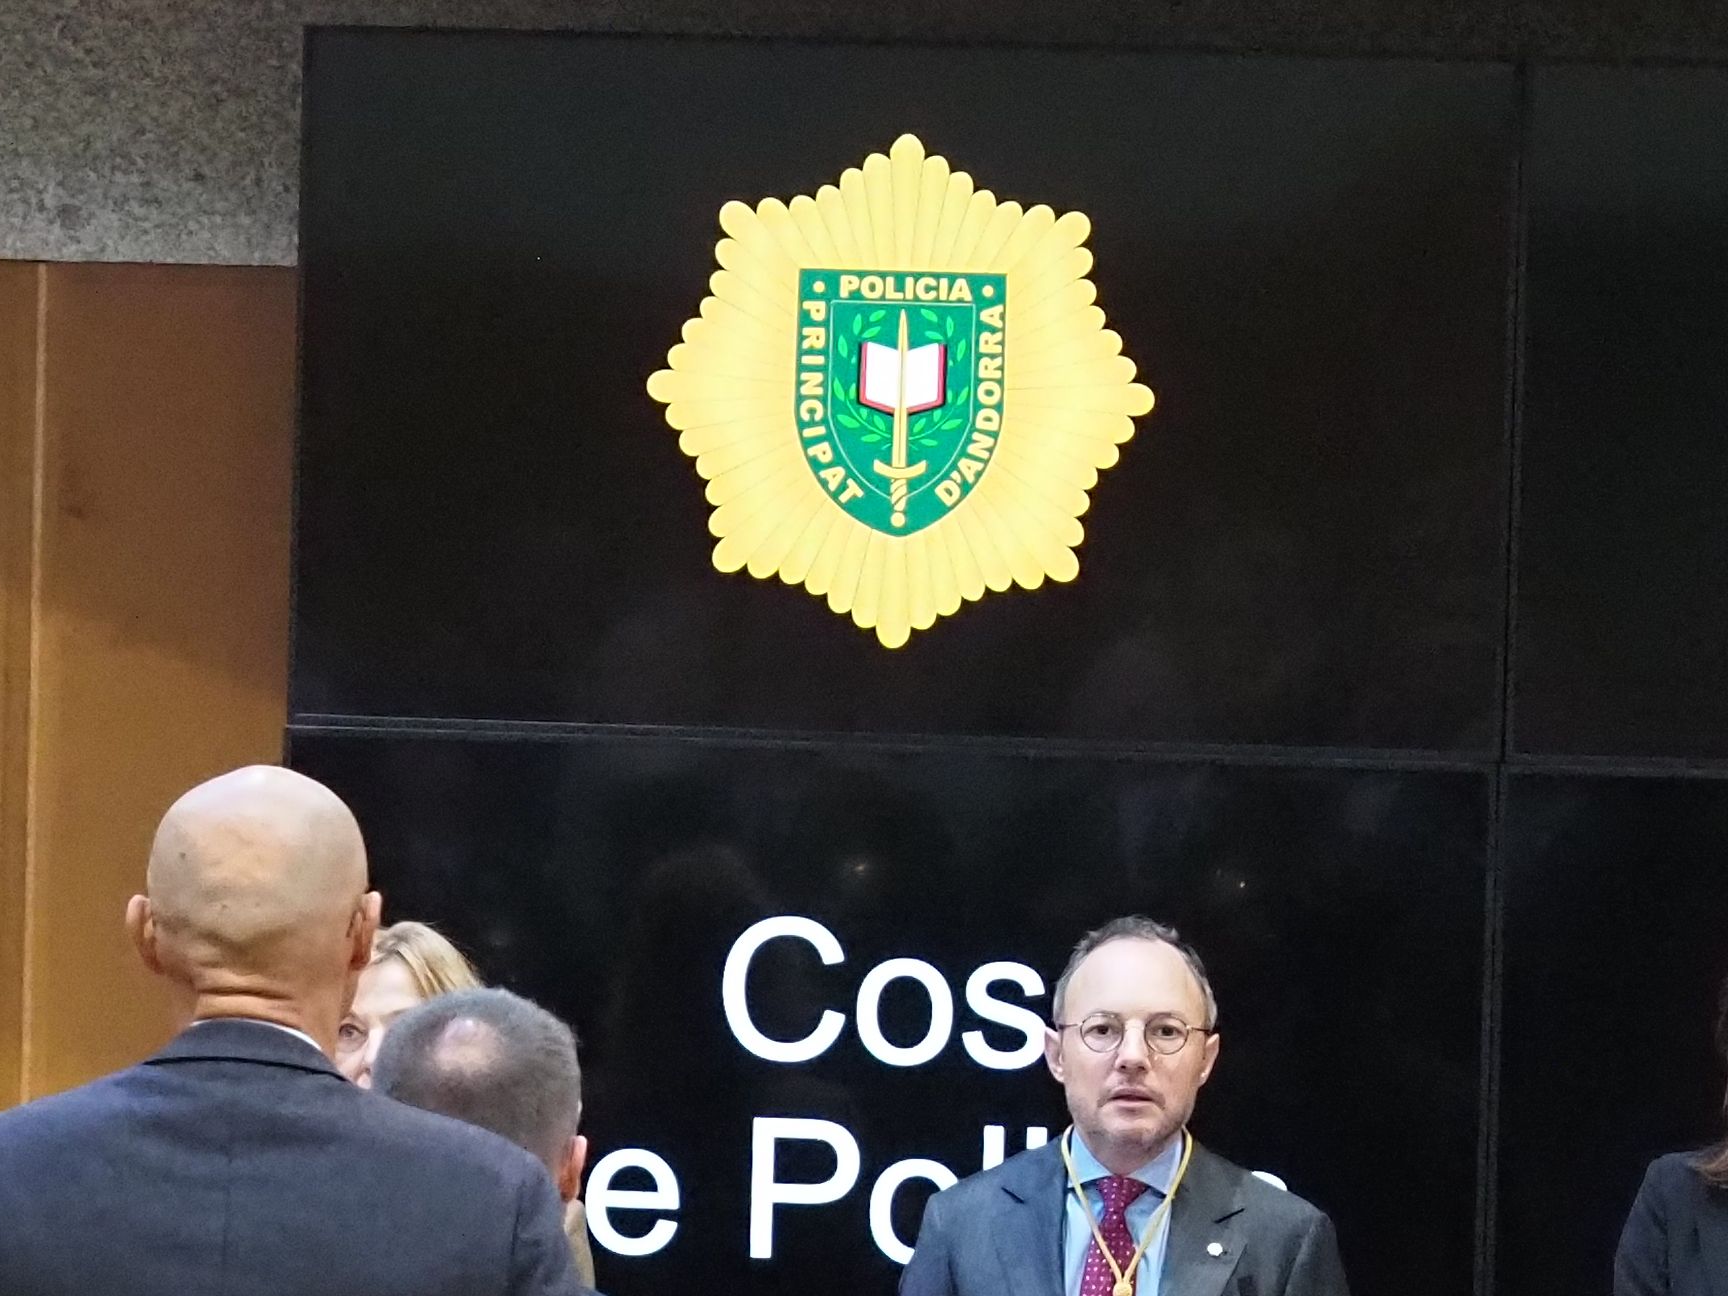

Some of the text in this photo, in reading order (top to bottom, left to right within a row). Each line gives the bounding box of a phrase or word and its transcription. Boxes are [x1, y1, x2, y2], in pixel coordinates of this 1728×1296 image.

[838, 274, 973, 302] POLICIA
[799, 300, 865, 504] PRINCIPAT
[934, 303, 1004, 507] D'ANDORRA
[721, 915, 1047, 1071] Cos
